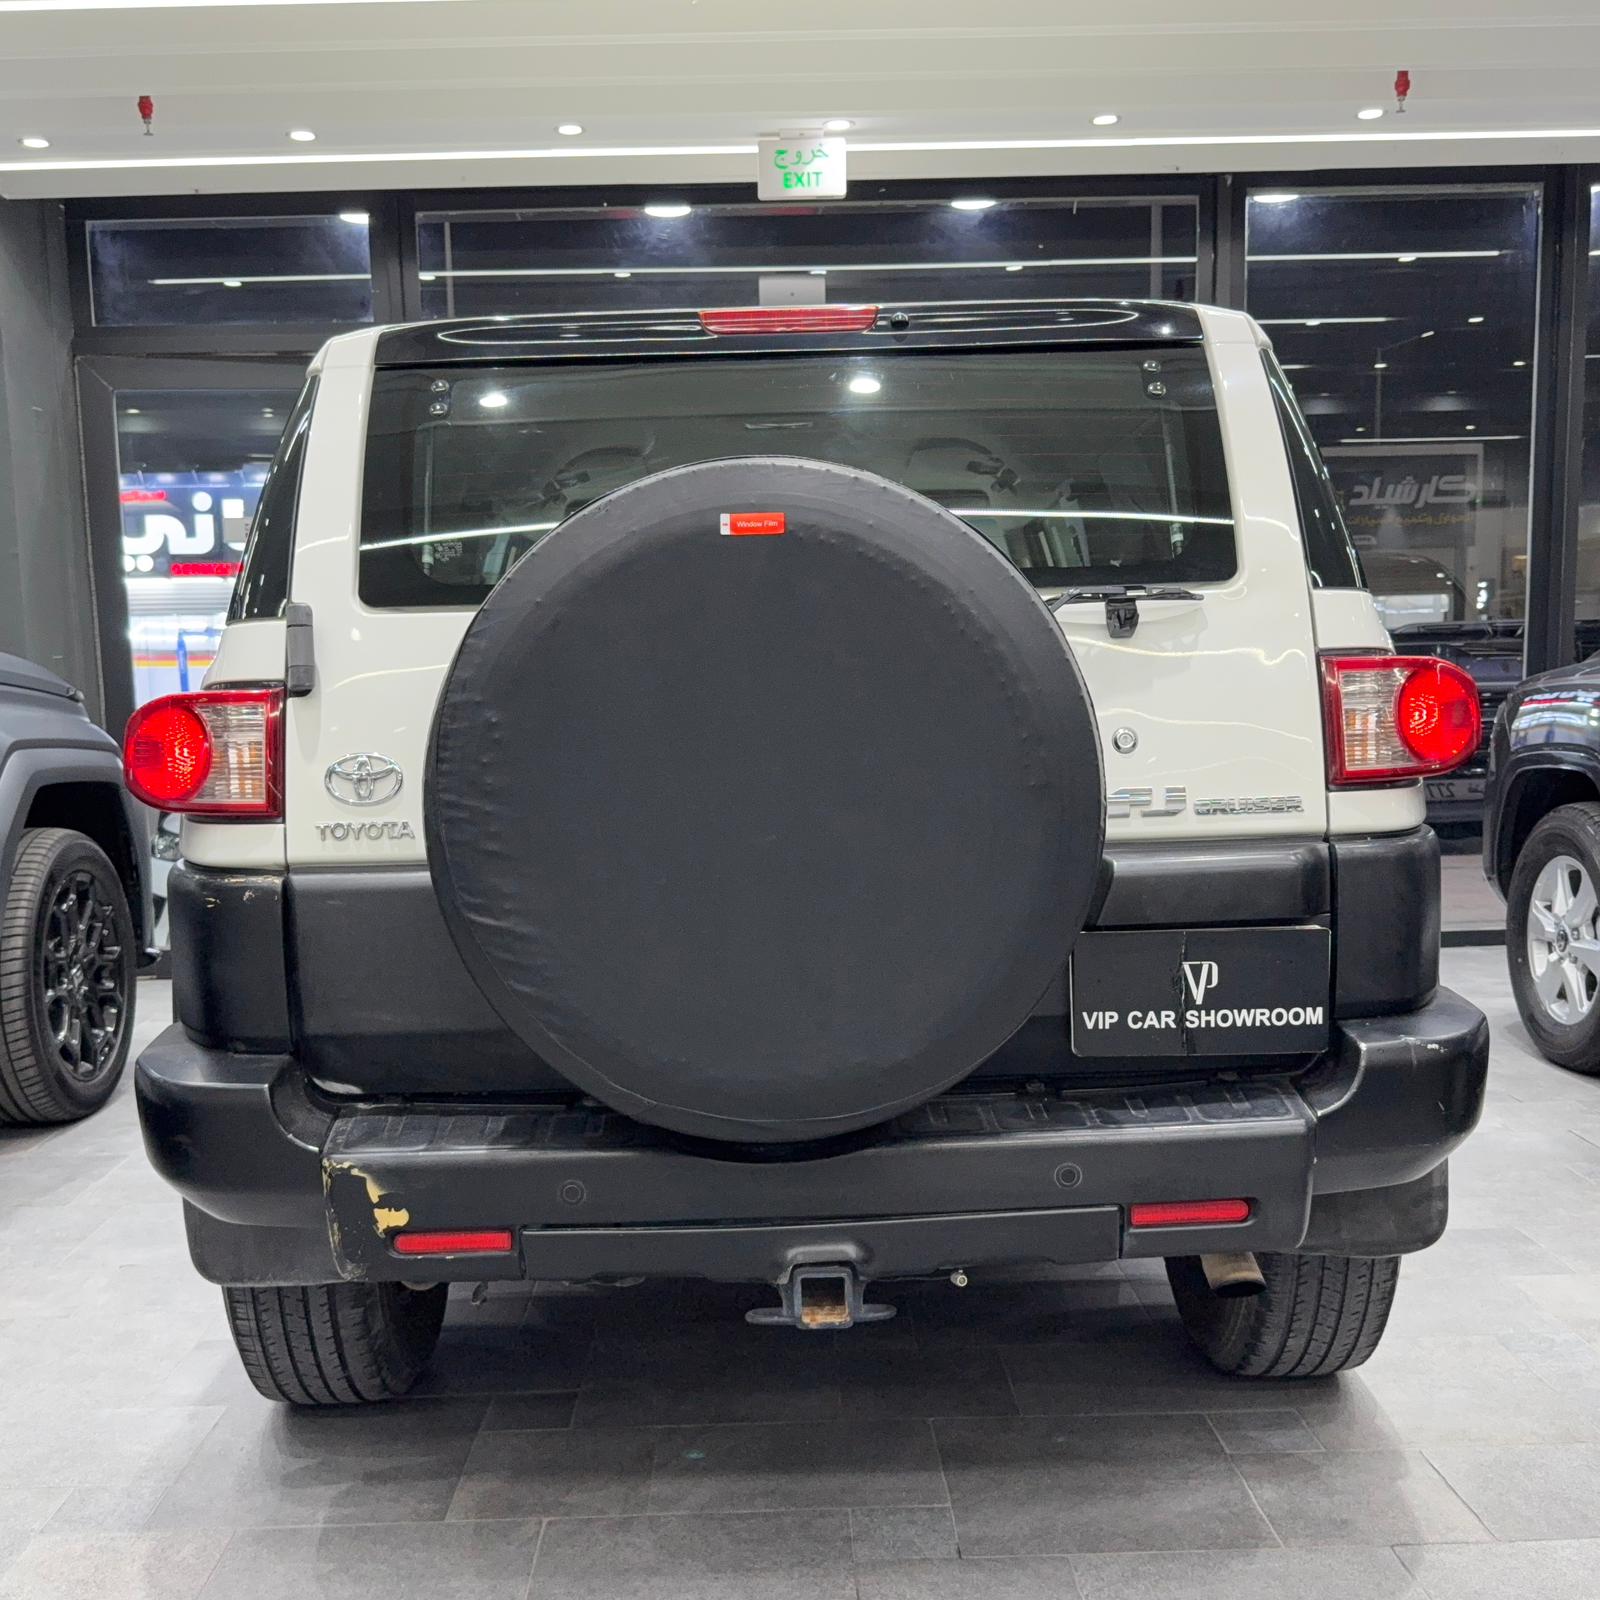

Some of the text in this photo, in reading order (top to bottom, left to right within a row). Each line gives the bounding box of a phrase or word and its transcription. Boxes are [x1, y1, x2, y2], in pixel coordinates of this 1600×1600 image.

[774, 143, 829, 170] خروج
[783, 171, 823, 189] EXIT
[736, 520, 763, 529] Window
[764, 519, 779, 528] Film
[1193, 795, 1304, 816] CRUISER
[315, 821, 416, 841] TOYOTA
[1082, 1006, 1324, 1030] VIP CAR SHOWROOM
